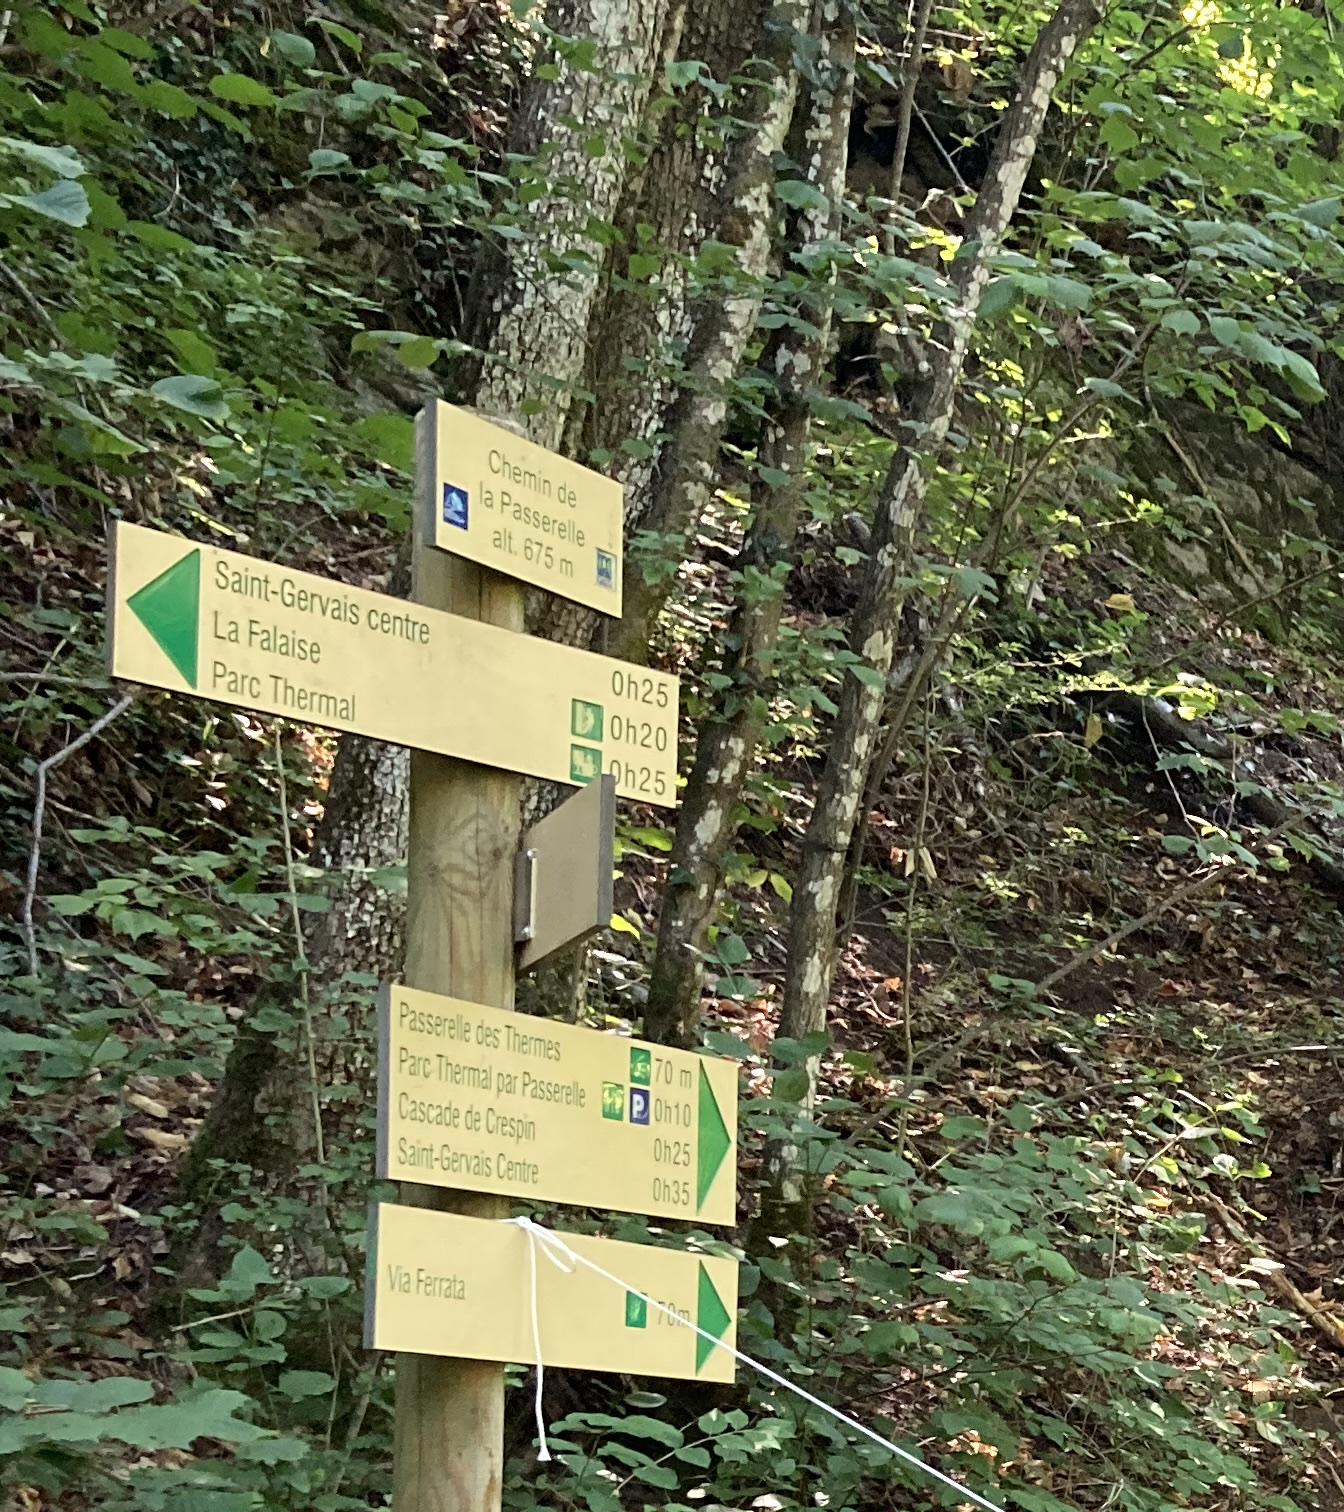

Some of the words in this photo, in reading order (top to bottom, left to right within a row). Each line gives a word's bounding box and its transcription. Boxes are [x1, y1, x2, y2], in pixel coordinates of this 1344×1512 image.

[488, 450, 551, 498] Chemin
[557, 482, 577, 508] de
[480, 481, 493, 508] la
[501, 491, 585, 547] Passerelle
[493, 528, 517, 555] alt.
[524, 538, 553, 569] 675
[560, 557, 573, 578] m
[215, 561, 360, 626] Saint-Gervais
[367, 608, 430, 645] centre
[213, 611, 240, 644] La
[247, 618, 321, 664] Falaise
[212, 661, 261, 699] Parc
[269, 674, 356, 722] Thermal
[612, 670, 668, 708] 0h25
[611, 715, 667, 751] 0h20
[400, 1002, 473, 1044] Passerelle
[476, 1016, 501, 1047] des
[505, 1025, 561, 1062] Thermes
[399, 1047, 430, 1077] Parc
[436, 1053, 492, 1088] Thermal
[496, 1070, 519, 1098] par
[522, 1072, 586, 1109] Passerelle
[655, 1058, 673, 1084] 70
[680, 1069, 692, 1089] m
[399, 1093, 460, 1128] Cascade
[465, 1104, 482, 1131] de
[485, 1107, 536, 1143] Crespin
[655, 1098, 691, 1128] 0h10
[398, 1137, 492, 1178] Saint-Gervais
[497, 1153, 539, 1184] Centre
[654, 1138, 690, 1167] 0h25
[653, 1178, 690, 1206] 0h35
[388, 1264, 411, 1294] Via
[416, 1269, 466, 1300] Ferrata
